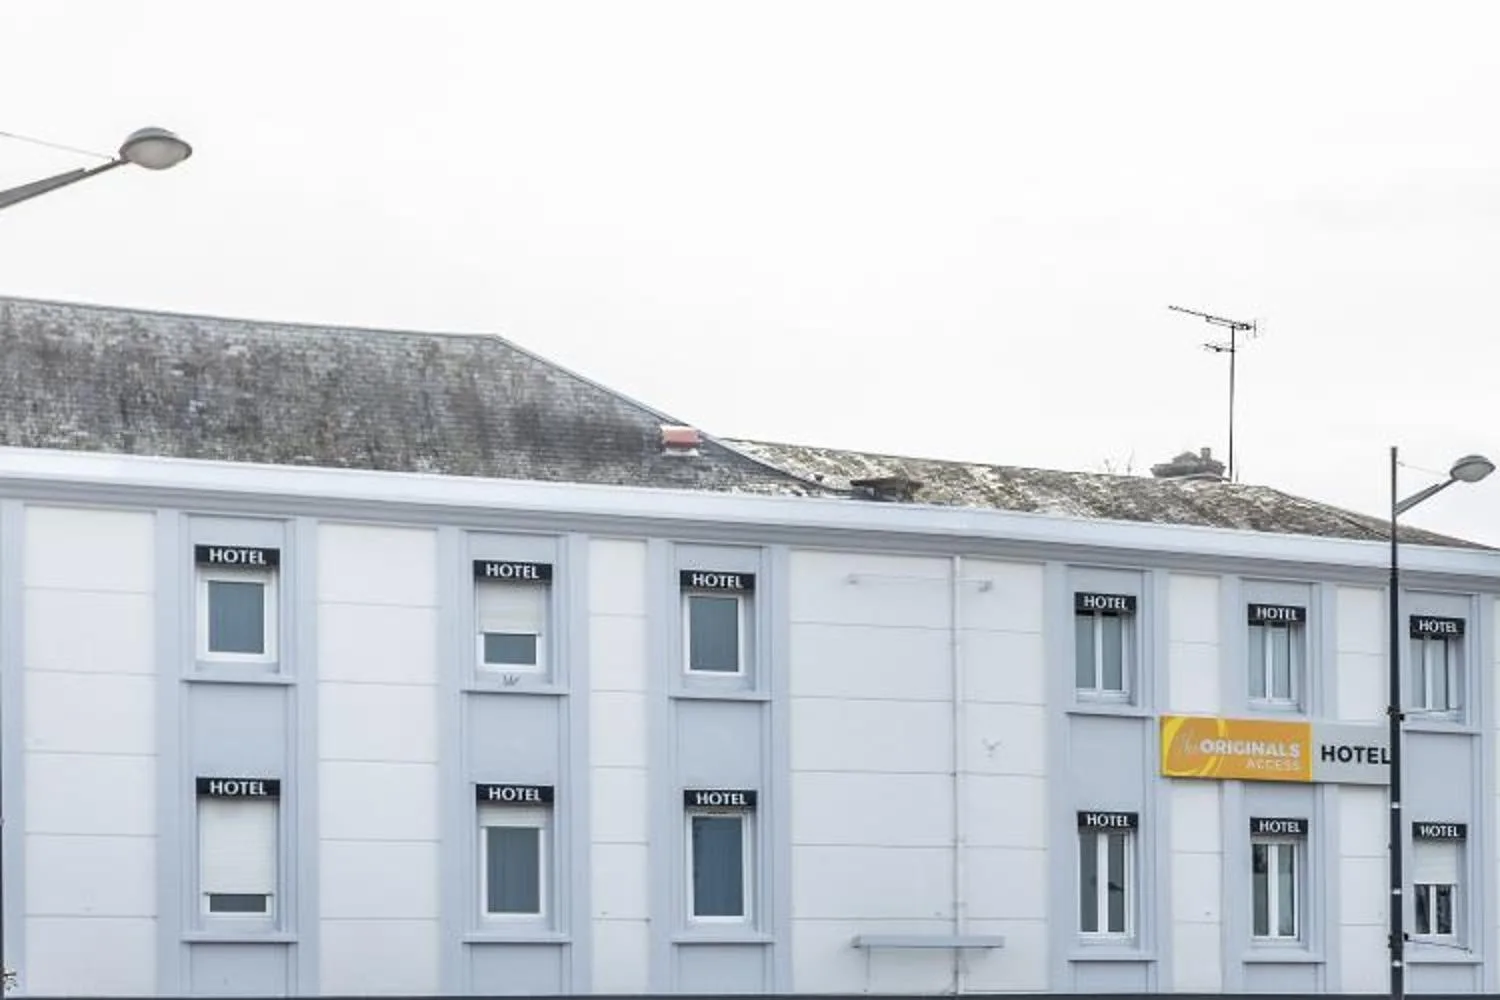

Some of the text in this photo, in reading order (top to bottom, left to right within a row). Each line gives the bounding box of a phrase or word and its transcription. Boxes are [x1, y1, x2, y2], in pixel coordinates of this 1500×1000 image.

[209, 547, 266, 565] HOTEL
[485, 563, 540, 580] HOTEL
[692, 573, 743, 589] HOTEL
[1083, 594, 1129, 611] HOTEL
[1256, 606, 1298, 622] HOTEL
[1418, 618, 1458, 634] HOTEL
[1199, 738, 1301, 757] ORIGINALS
[1321, 745, 1391, 765] HOTEL
[1245, 758, 1301, 771] ACCESS
[209, 779, 267, 796] HOTEL
[488, 785, 542, 803] HOTEL
[695, 791, 747, 806] HOTEL
[1086, 813, 1130, 829] HOTEL
[1259, 819, 1301, 834] HOTEL
[1420, 824, 1459, 839] HOTEL
